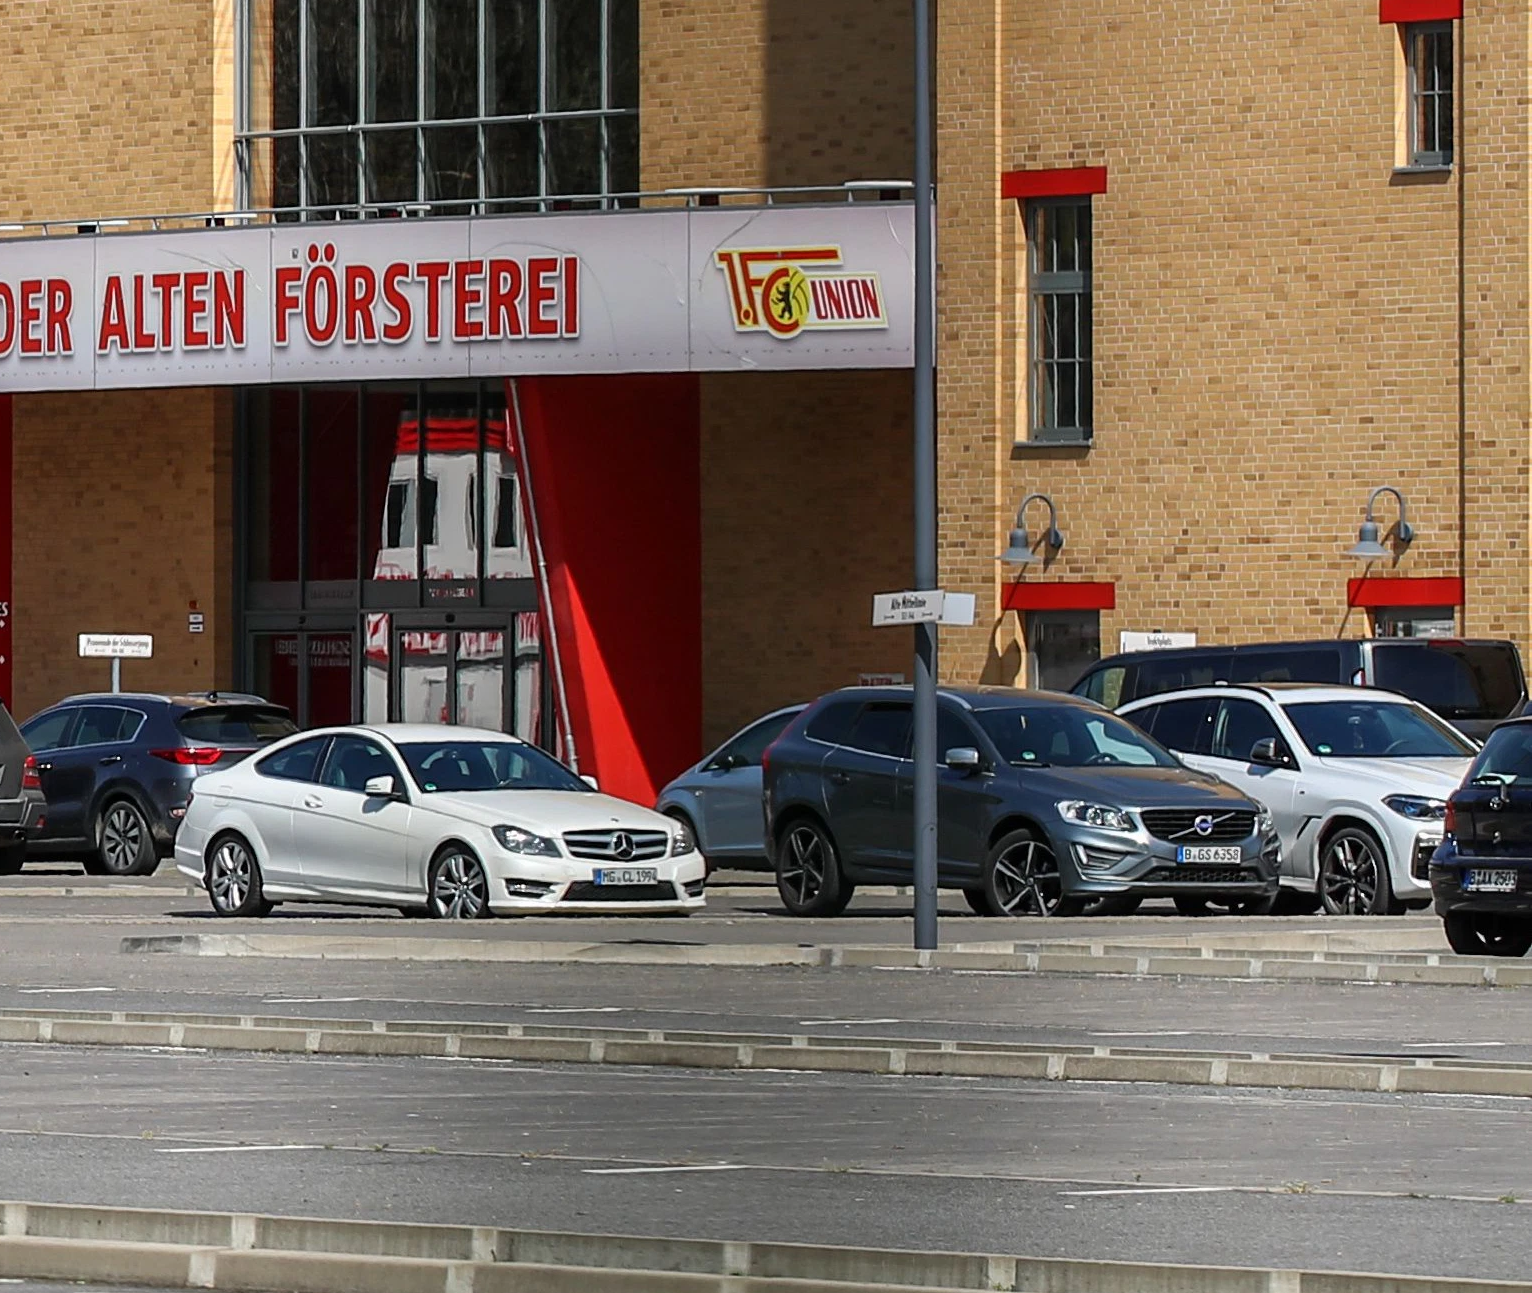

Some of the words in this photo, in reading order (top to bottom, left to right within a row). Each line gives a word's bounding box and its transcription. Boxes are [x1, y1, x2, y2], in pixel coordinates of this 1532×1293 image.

[98, 270, 246, 353] ALTEN
[274, 242, 579, 343] FÖRSTEREI
[810, 278, 882, 320] UNION
[1198, 849, 1212, 860] GS
[1213, 849, 1239, 861] 6358
